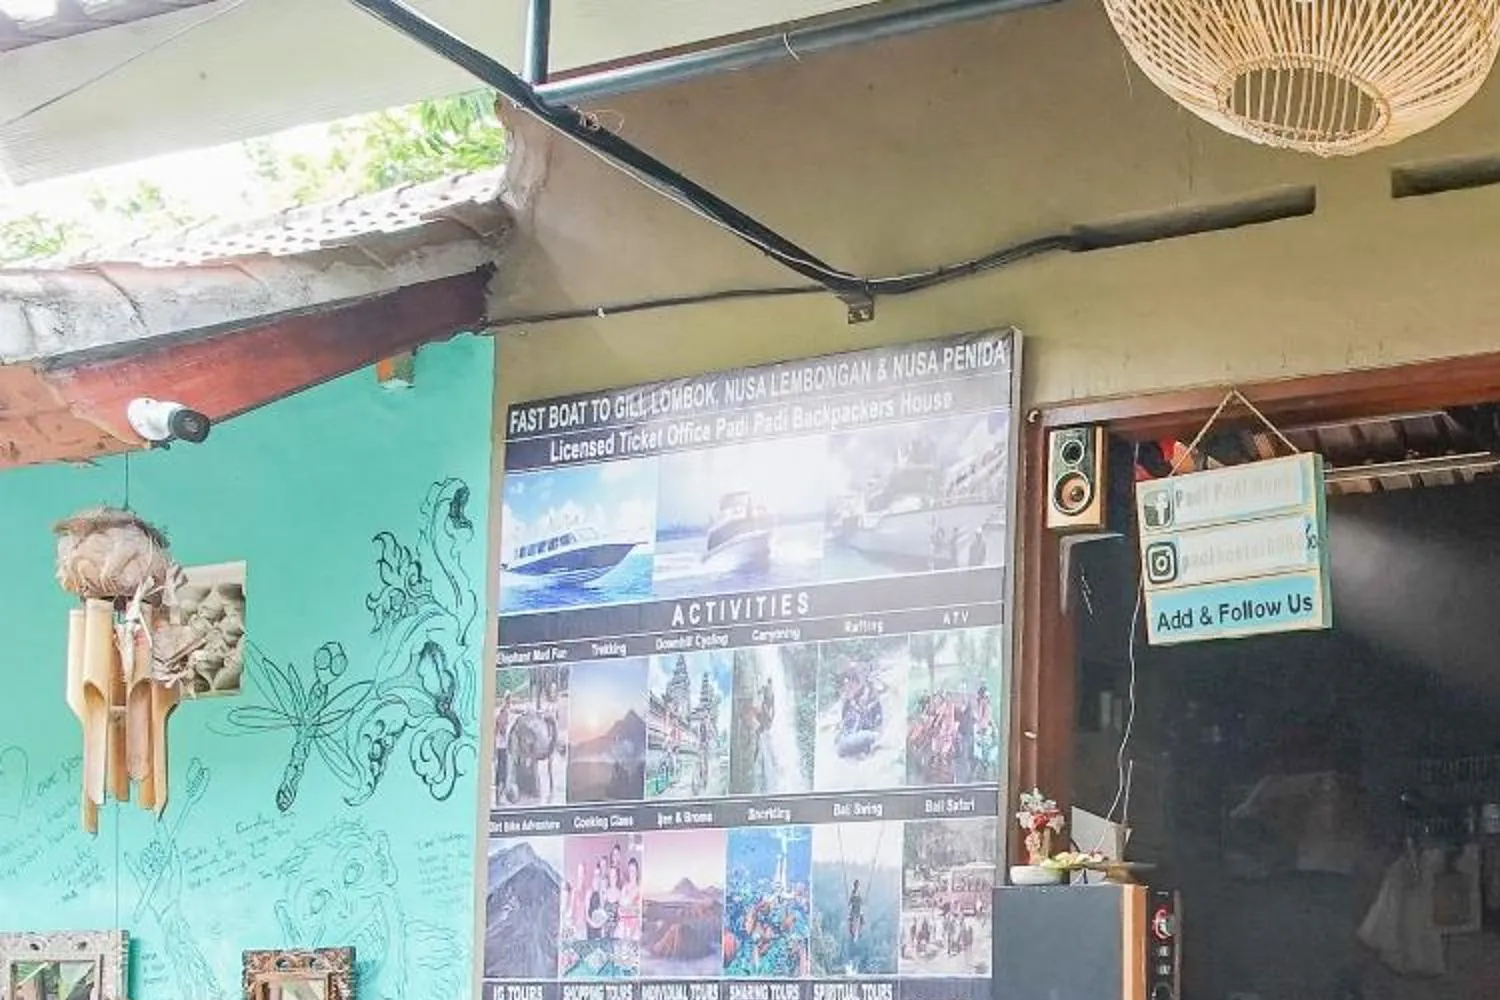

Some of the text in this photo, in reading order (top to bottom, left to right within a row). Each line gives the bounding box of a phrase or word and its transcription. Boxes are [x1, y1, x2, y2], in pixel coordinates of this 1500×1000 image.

[509, 406, 546, 434] FAST
[549, 398, 588, 429] BOAT
[591, 395, 611, 423] TO
[725, 374, 767, 405] NUSA
[770, 362, 871, 397] LEMBONGAN
[878, 356, 889, 383] &
[893, 348, 938, 381] NUSA
[942, 338, 1006, 372] PENIDA
[550, 389, 952, 463] Licensed Ticket Office Padi Padi Backpackers House
[671, 592, 810, 628] ACTIVITIES
[1157, 592, 1313, 632] Add & Follow Us
[591, 640, 628, 658] Trekking
[572, 812, 611, 832] Cooking
